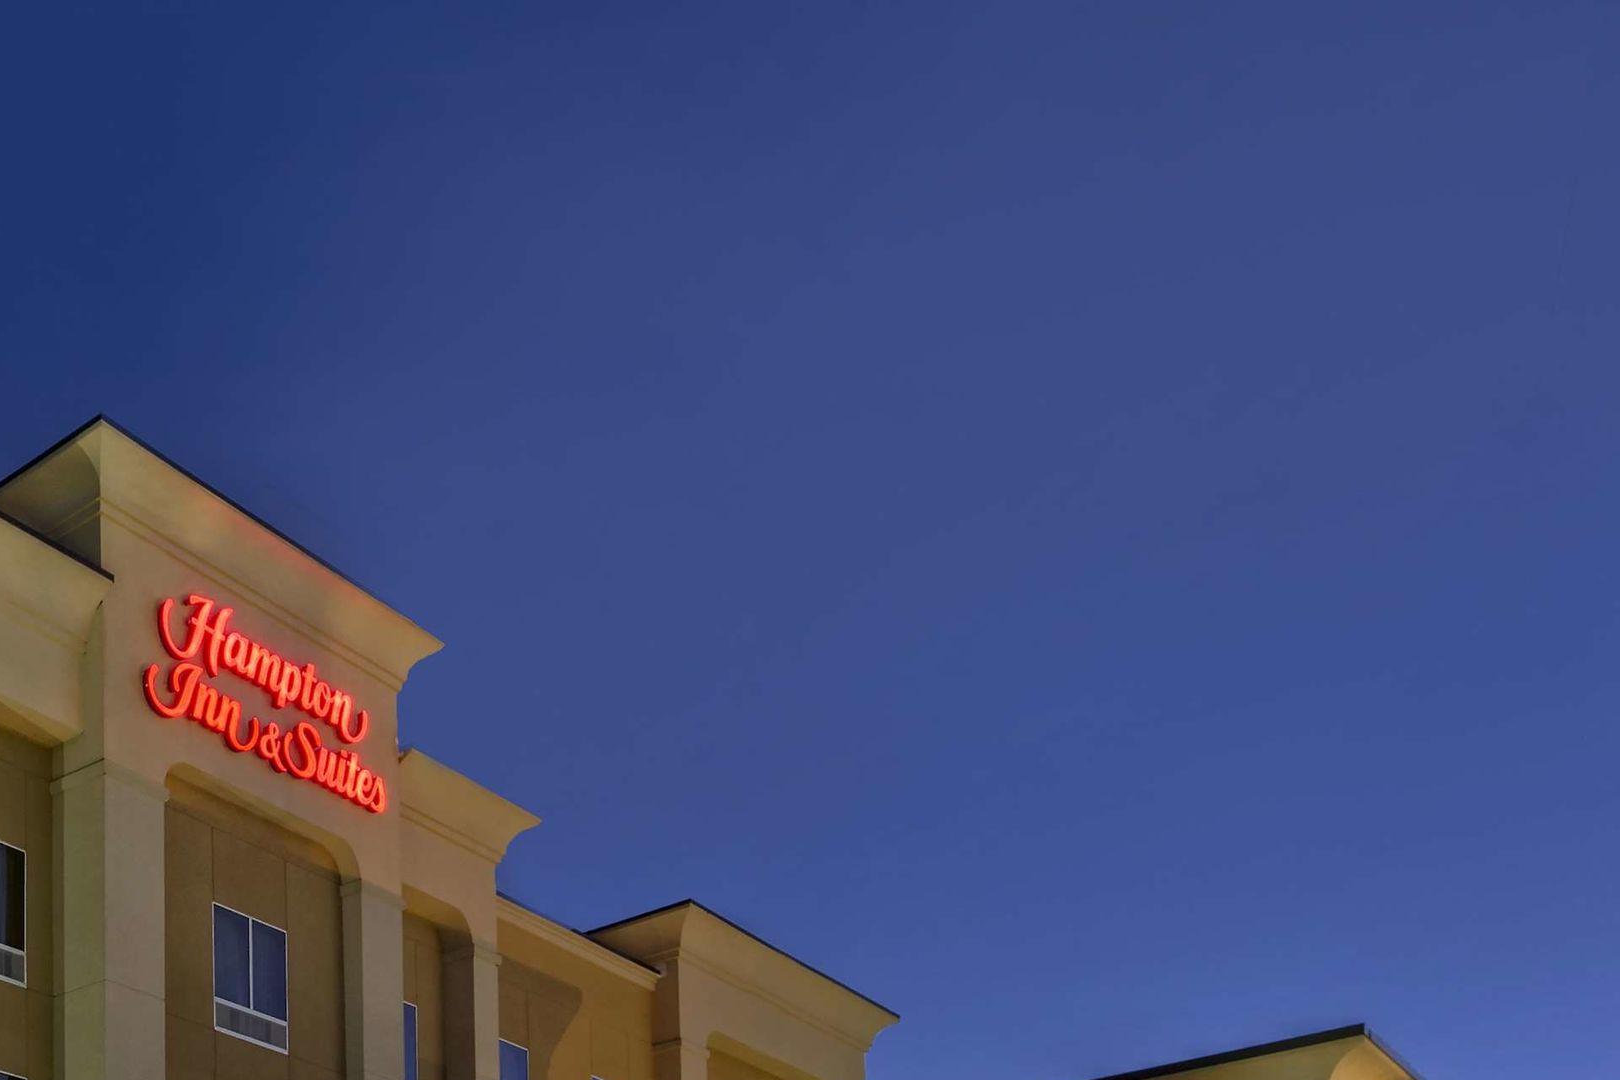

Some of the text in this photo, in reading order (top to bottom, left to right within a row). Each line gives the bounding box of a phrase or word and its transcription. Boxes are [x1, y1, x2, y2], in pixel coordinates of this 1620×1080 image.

[143, 662, 386, 814] Inn & Suites
[157, 595, 368, 743] Hampton
